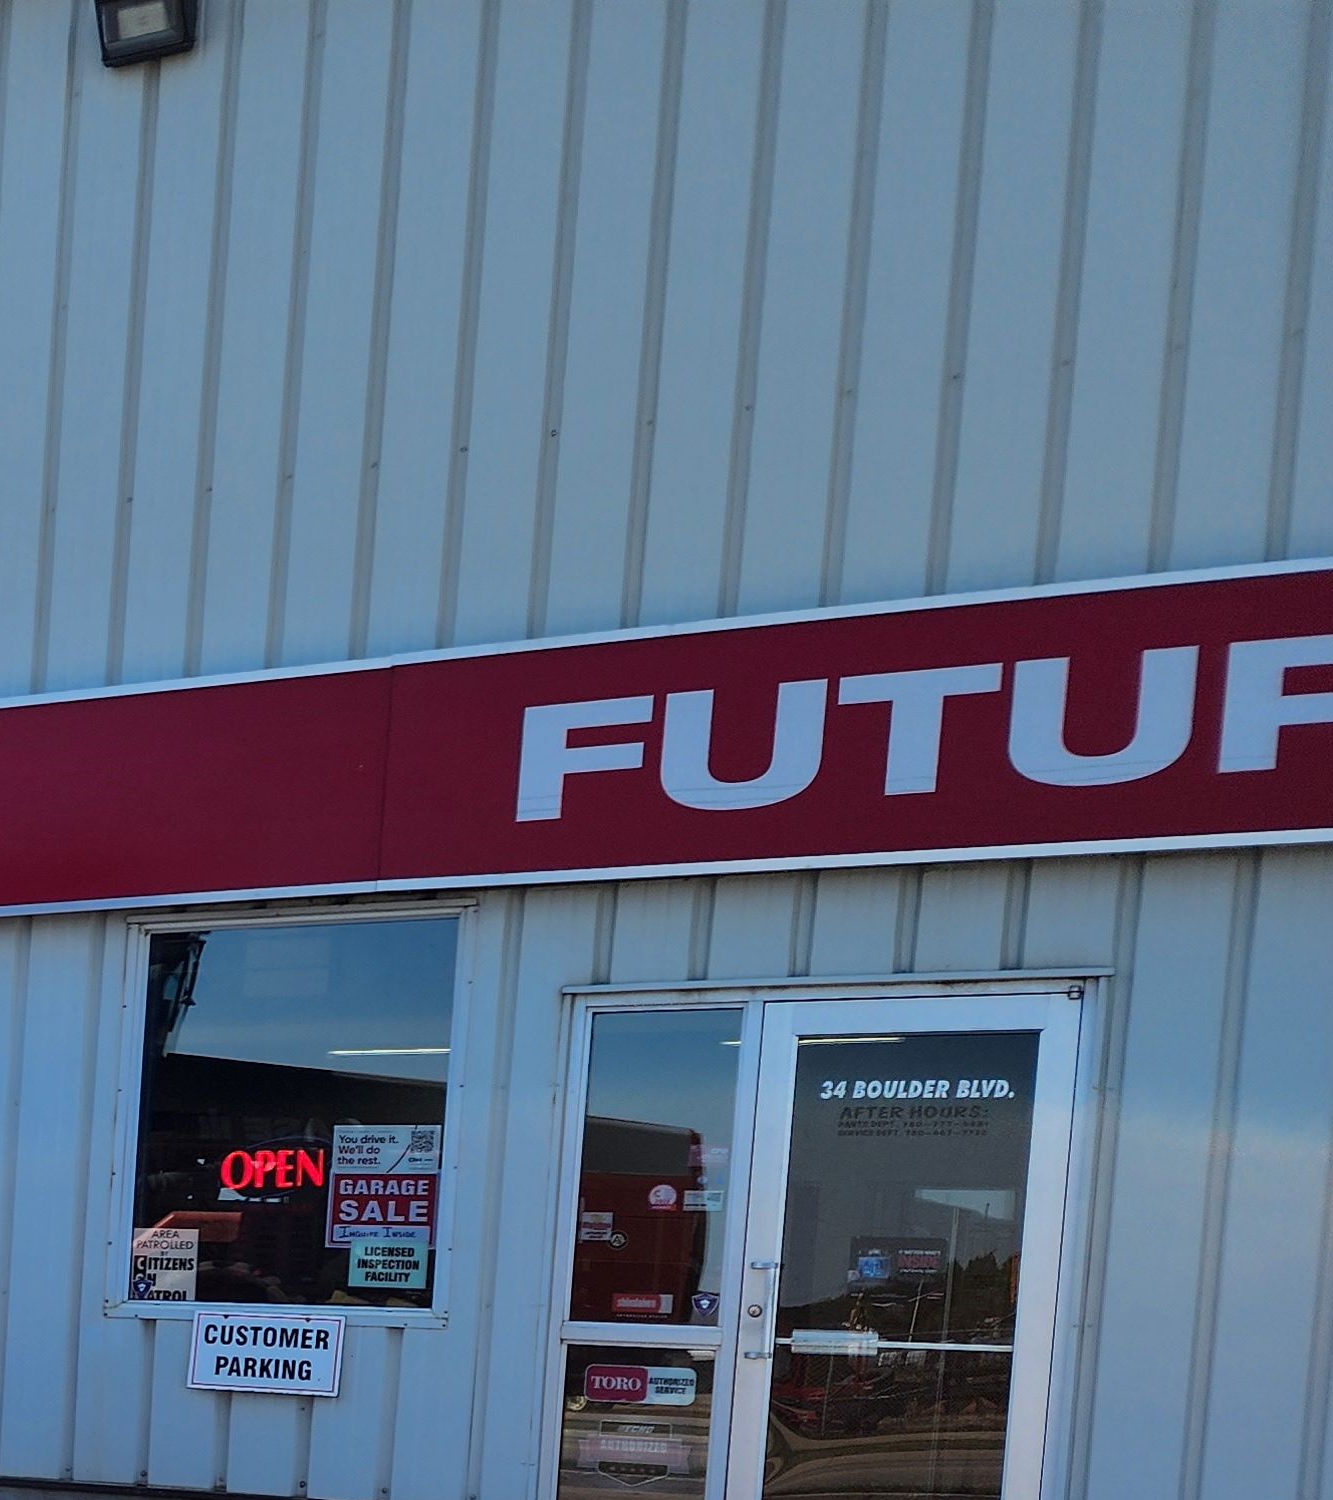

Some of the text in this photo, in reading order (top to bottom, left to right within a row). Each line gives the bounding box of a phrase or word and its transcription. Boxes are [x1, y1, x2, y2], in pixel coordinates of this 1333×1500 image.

[820, 1079, 1015, 1099] 34 BOULDER BLVD.
[839, 1106, 903, 1121] AFTER
[338, 1134, 400, 1144] You drive it.
[338, 1145, 381, 1154] We'll do
[337, 1156, 381, 1165] the rest.
[220, 1148, 324, 1190] OPEN
[339, 1179, 429, 1195] GARAGE
[338, 1200, 429, 1222] SALE
[151, 1229, 180, 1239] AREA
[136, 1240, 194, 1250] PATROLLED
[364, 1246, 415, 1258] LICENSED
[136, 1257, 195, 1271] CITIZENS
[357, 1258, 420, 1270] INSPECTION
[365, 1271, 411, 1283] FACILITY
[204, 1324, 330, 1350] CUSTOMER
[214, 1356, 312, 1381] PARKING
[590, 1376, 642, 1391] TORO
